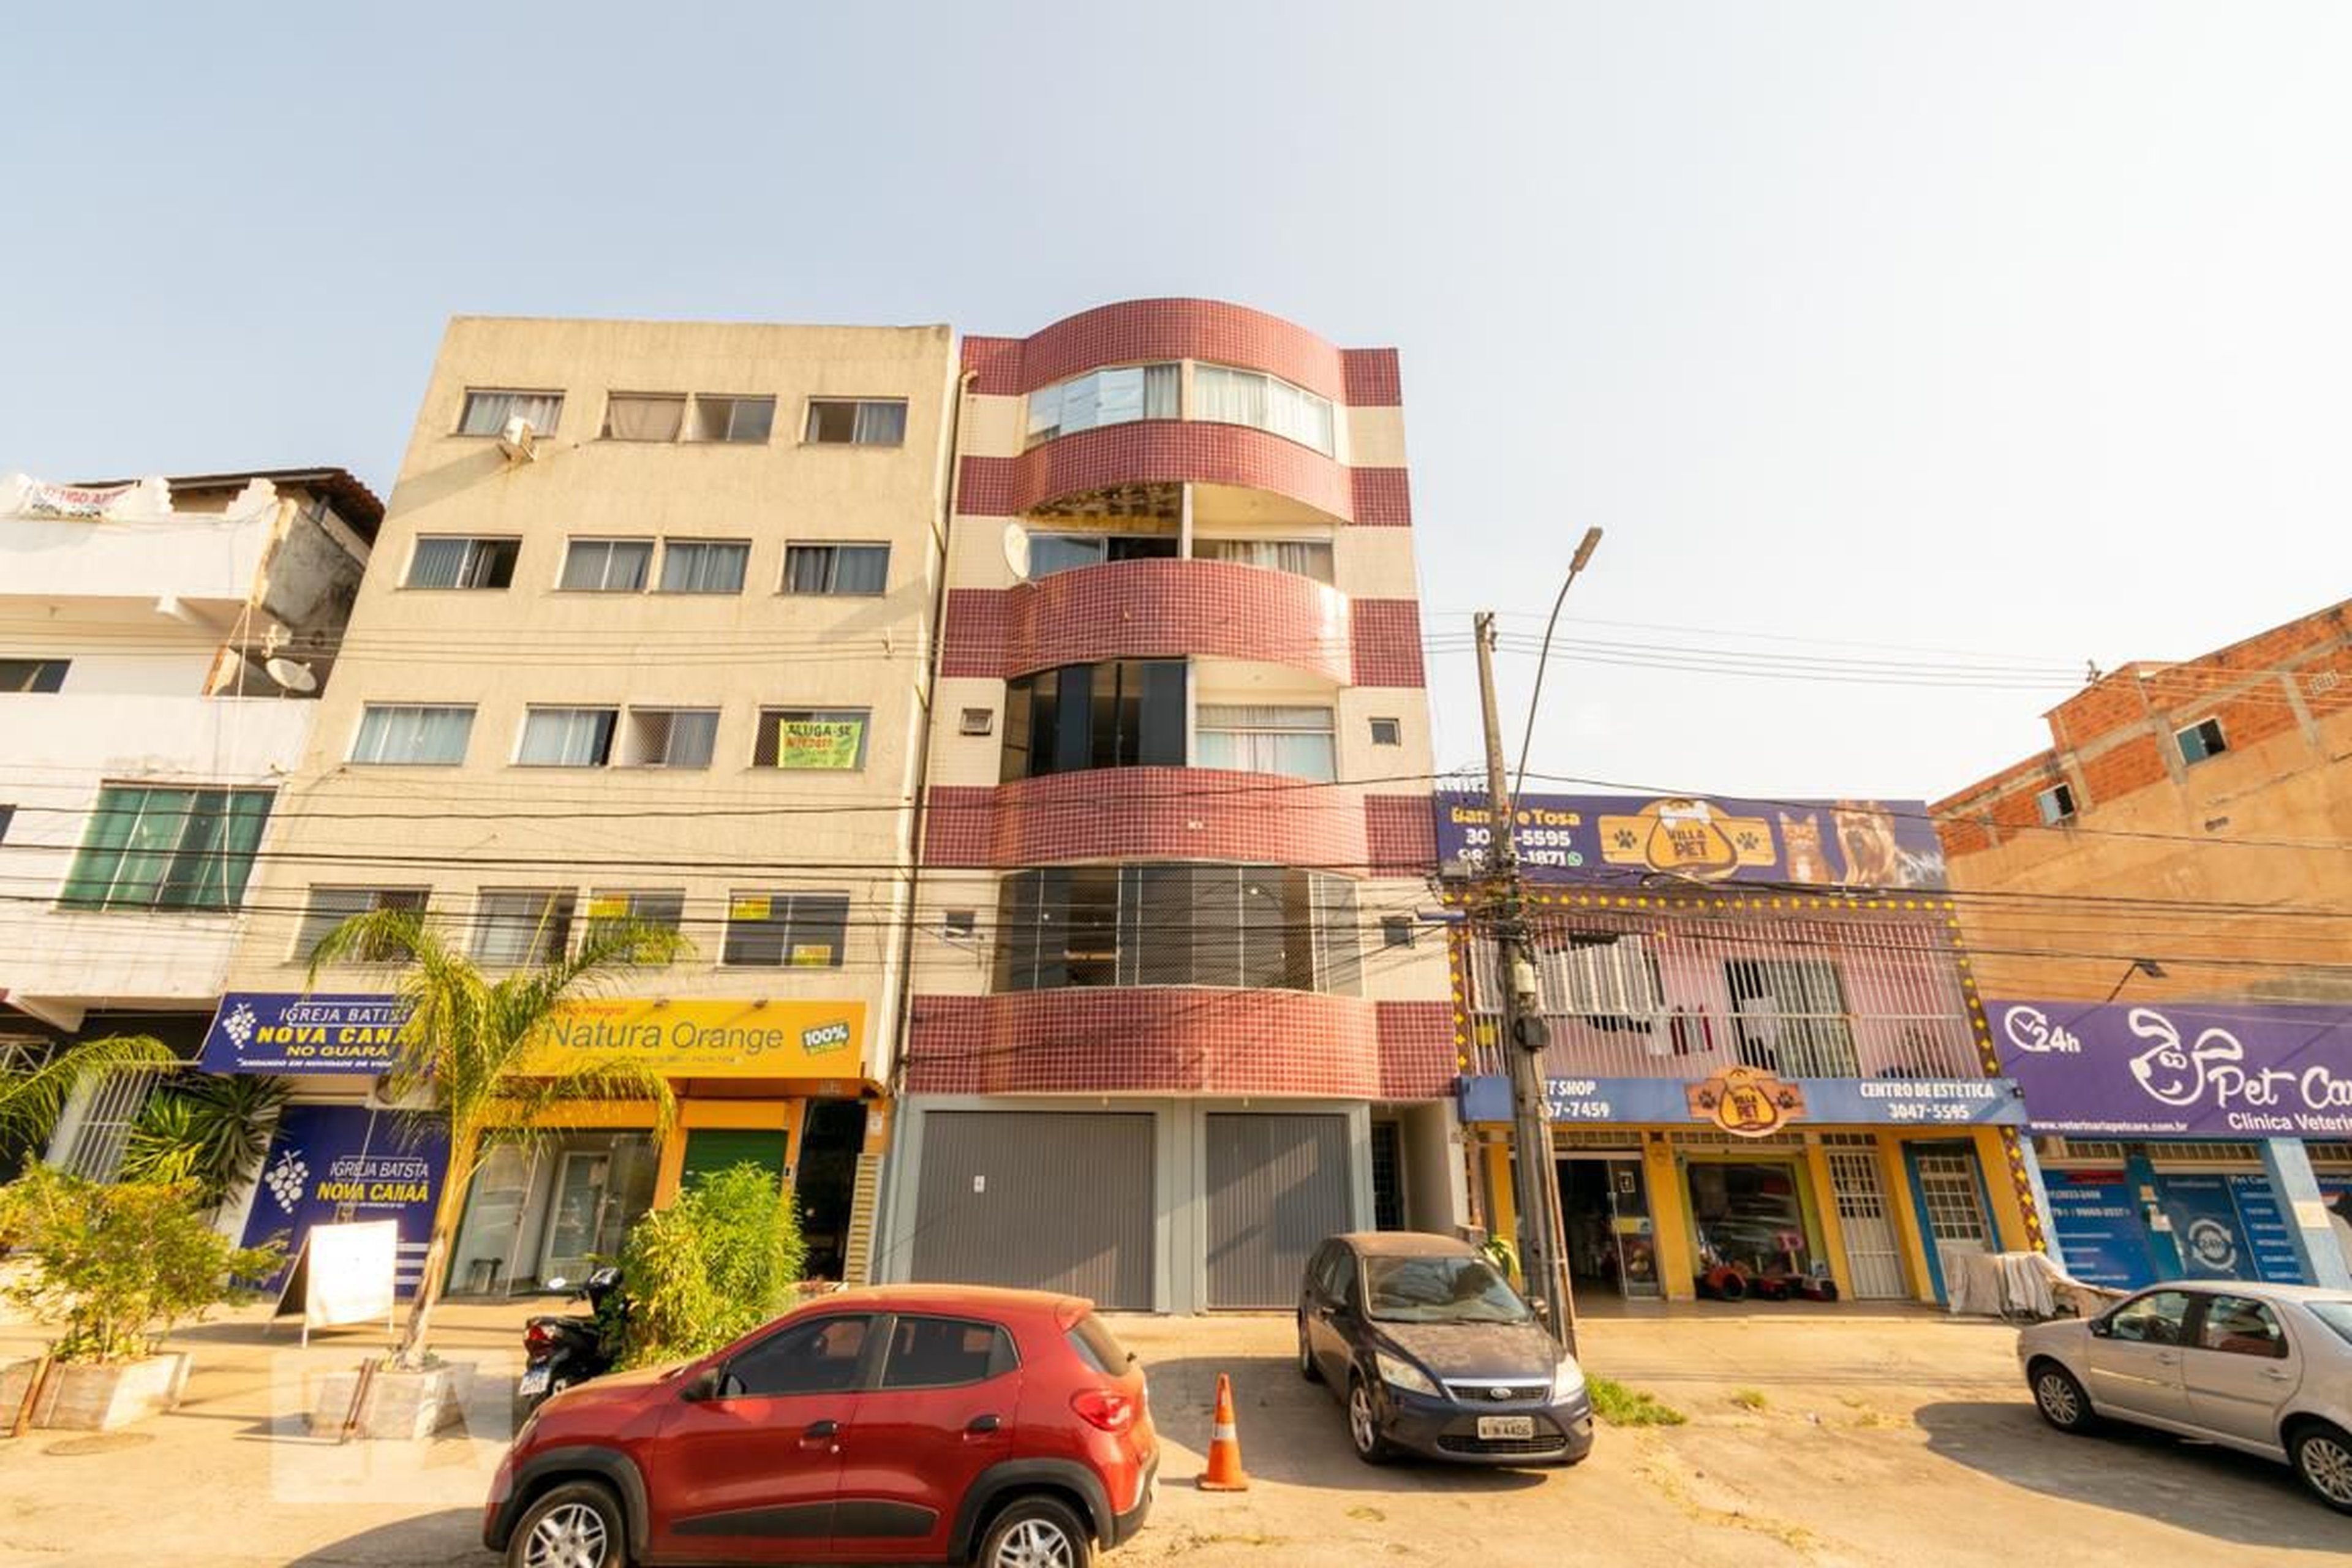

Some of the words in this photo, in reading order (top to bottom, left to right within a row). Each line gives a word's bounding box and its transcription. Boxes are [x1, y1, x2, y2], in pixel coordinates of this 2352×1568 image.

[1517, 811, 1531, 825] e
[1532, 809, 1581, 826] Tosa
[1466, 828, 1571, 847] 30-5595
[1667, 829, 1708, 840] VILLA
[1673, 842, 1707, 856] PET
[279, 1008, 339, 1022] IGREJA
[256, 1027, 327, 1044] NOVA
[543, 1018, 662, 1049] Natura
[671, 1022, 783, 1055] Orange
[804, 1024, 848, 1046] 100%
[2031, 1026, 2081, 1053] 24h
[286, 1046, 315, 1057] NO
[1558, 1080, 1596, 1096] SHOP
[1860, 1082, 1913, 1098] CENTRO
[1915, 1082, 1931, 1098] DE
[2207, 1065, 2297, 1108] Pet
[1889, 1103, 1970, 1119] 3047-5595
[317, 1182, 364, 1200] NOVA
